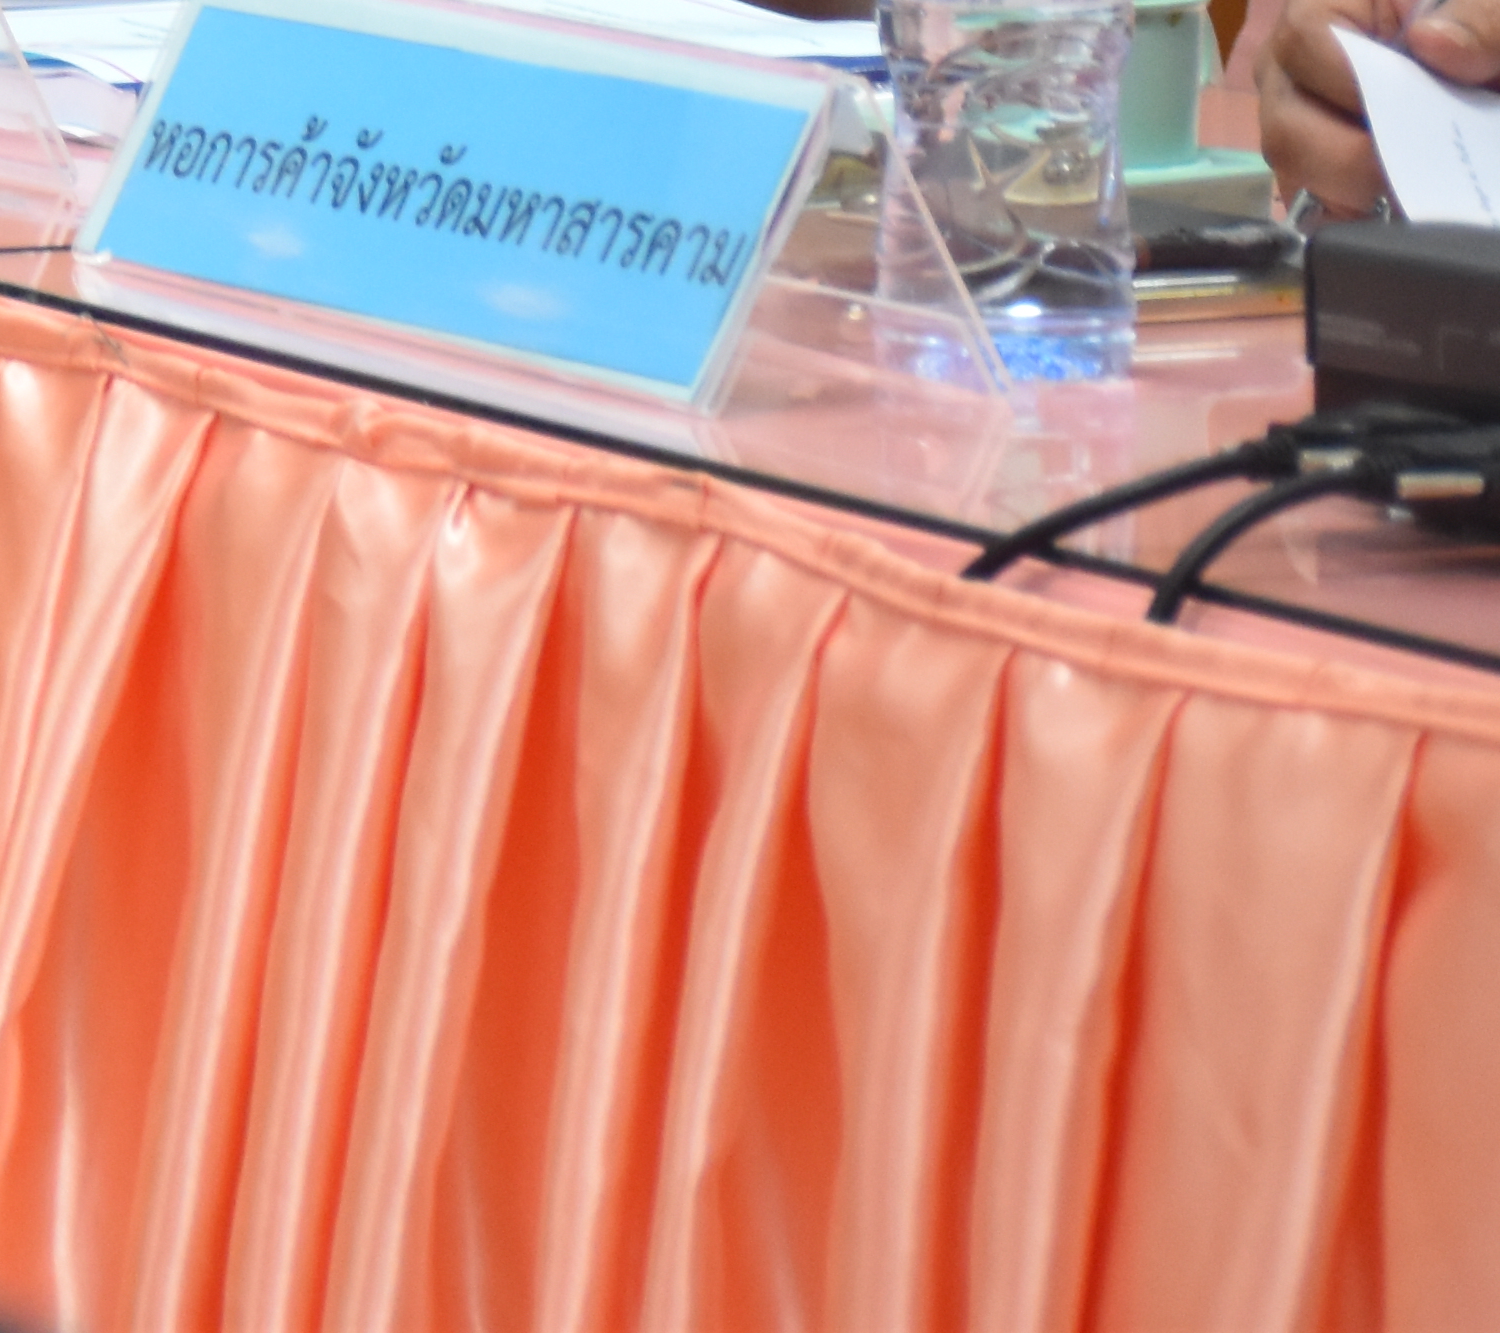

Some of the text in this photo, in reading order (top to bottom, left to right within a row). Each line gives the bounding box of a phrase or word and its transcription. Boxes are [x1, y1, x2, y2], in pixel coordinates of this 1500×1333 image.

[143, 113, 750, 288] หอการค้าจังหวัดมหาสารคาม
